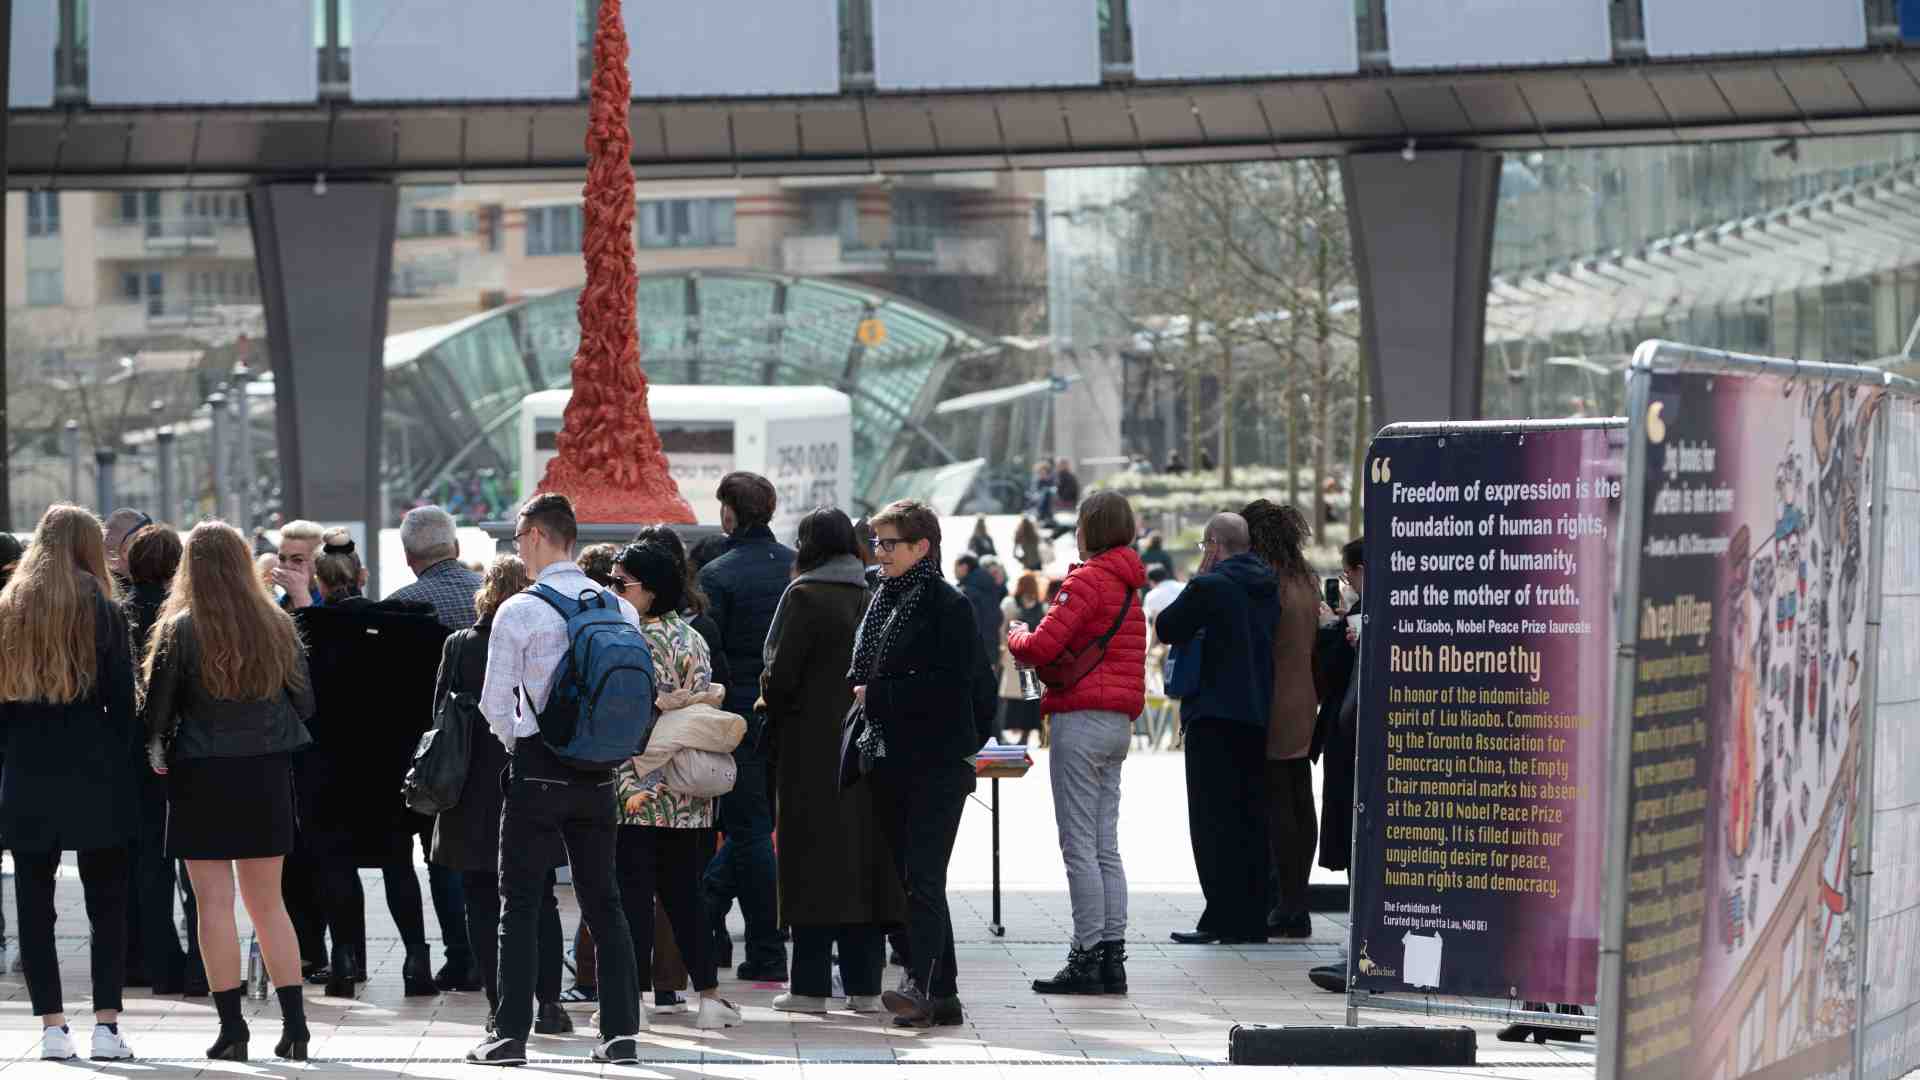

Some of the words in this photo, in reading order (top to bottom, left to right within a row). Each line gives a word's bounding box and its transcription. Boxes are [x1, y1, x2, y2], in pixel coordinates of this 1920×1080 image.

[1392, 481, 1459, 503] Freedom
[1464, 480, 1480, 501] of
[1485, 478, 1571, 506] expression
[1575, 477, 1589, 498] is
[1594, 477, 1621, 499] the
[1391, 515, 1474, 537] foundation
[1478, 514, 1495, 535] of
[1499, 514, 1552, 535] human
[1557, 513, 1607, 540] rights,
[1390, 550, 1416, 572] the
[1420, 554, 1474, 572] source
[1479, 549, 1496, 570] of
[1500, 548, 1577, 576] humanity,
[1390, 584, 1419, 606] and
[1423, 584, 1449, 606] the
[1454, 584, 1509, 606] mother
[1515, 584, 1532, 605] of
[1535, 583, 1580, 606] truth.
[1398, 618, 1414, 633] Liu
[1416, 618, 1453, 635] Xiaobo,
[1456, 618, 1486, 633] Nobel
[1488, 619, 1519, 633] Peace
[1521, 618, 1547, 633] Prize
[1549, 619, 1592, 634] laureate
[1390, 645, 1433, 673] Ruth
[1439, 645, 1541, 682] Abernethy
[1389, 686, 1401, 703] In
[1404, 686, 1438, 703] honor
[1440, 686, 1454, 703] of
[1456, 686, 1476, 703] the
[1479, 687, 1550, 705] indomitable
[1388, 709, 1420, 729] spirit
[1422, 709, 1436, 726] of
[1440, 710, 1458, 727] Liu
[1460, 710, 1505, 728] Xiaobo.
[1507, 710, 1593, 729] Commission
[1387, 732, 1403, 752] by
[1406, 732, 1424, 748] the
[1427, 732, 1473, 750] Toronto
[1476, 733, 1543, 752] Association
[1547, 736, 1567, 752] for
[1387, 754, 1452, 777] Democracy
[1455, 756, 1466, 773] in
[1469, 756, 1506, 777] China,
[1509, 758, 1529, 775] the
[1531, 758, 1568, 780] Empty
[1387, 777, 1418, 794] Chair
[1420, 778, 1477, 796] memorial
[1479, 780, 1517, 797] marks
[1520, 781, 1537, 798] his
[1540, 782, 1588, 800] absen
[1387, 801, 1400, 817] at
[1403, 801, 1422, 817] the
[1424, 801, 1454, 819] 2010
[1456, 803, 1490, 820] Nobel
[1493, 804, 1529, 822] Peace
[1531, 805, 1562, 823] Prize
[1386, 824, 1449, 846] ceremony.
[1452, 825, 1463, 842] It
[1465, 825, 1474, 842] is
[1478, 825, 1509, 844] filled
[1511, 827, 1539, 846] with
[1542, 831, 1563, 847] our
[1386, 848, 1447, 869] unyielding
[1450, 848, 1488, 867] desire
[1490, 850, 1508, 868] for
[1511, 853, 1550, 872] peace,
[1385, 870, 1424, 888] human
[1427, 871, 1463, 892] rights
[1466, 872, 1488, 890] and
[1490, 873, 1560, 898] democracy.
[1383, 901, 1396, 912] The
[1396, 902, 1430, 914] Forbidden
[1430, 903, 1441, 914] Art
[1383, 915, 1410, 927] Curated
[1411, 917, 1420, 929] by
[1421, 917, 1446, 929] Loretta
[1447, 918, 1462, 930] Lau,
[1463, 920, 1476, 931] NGO
